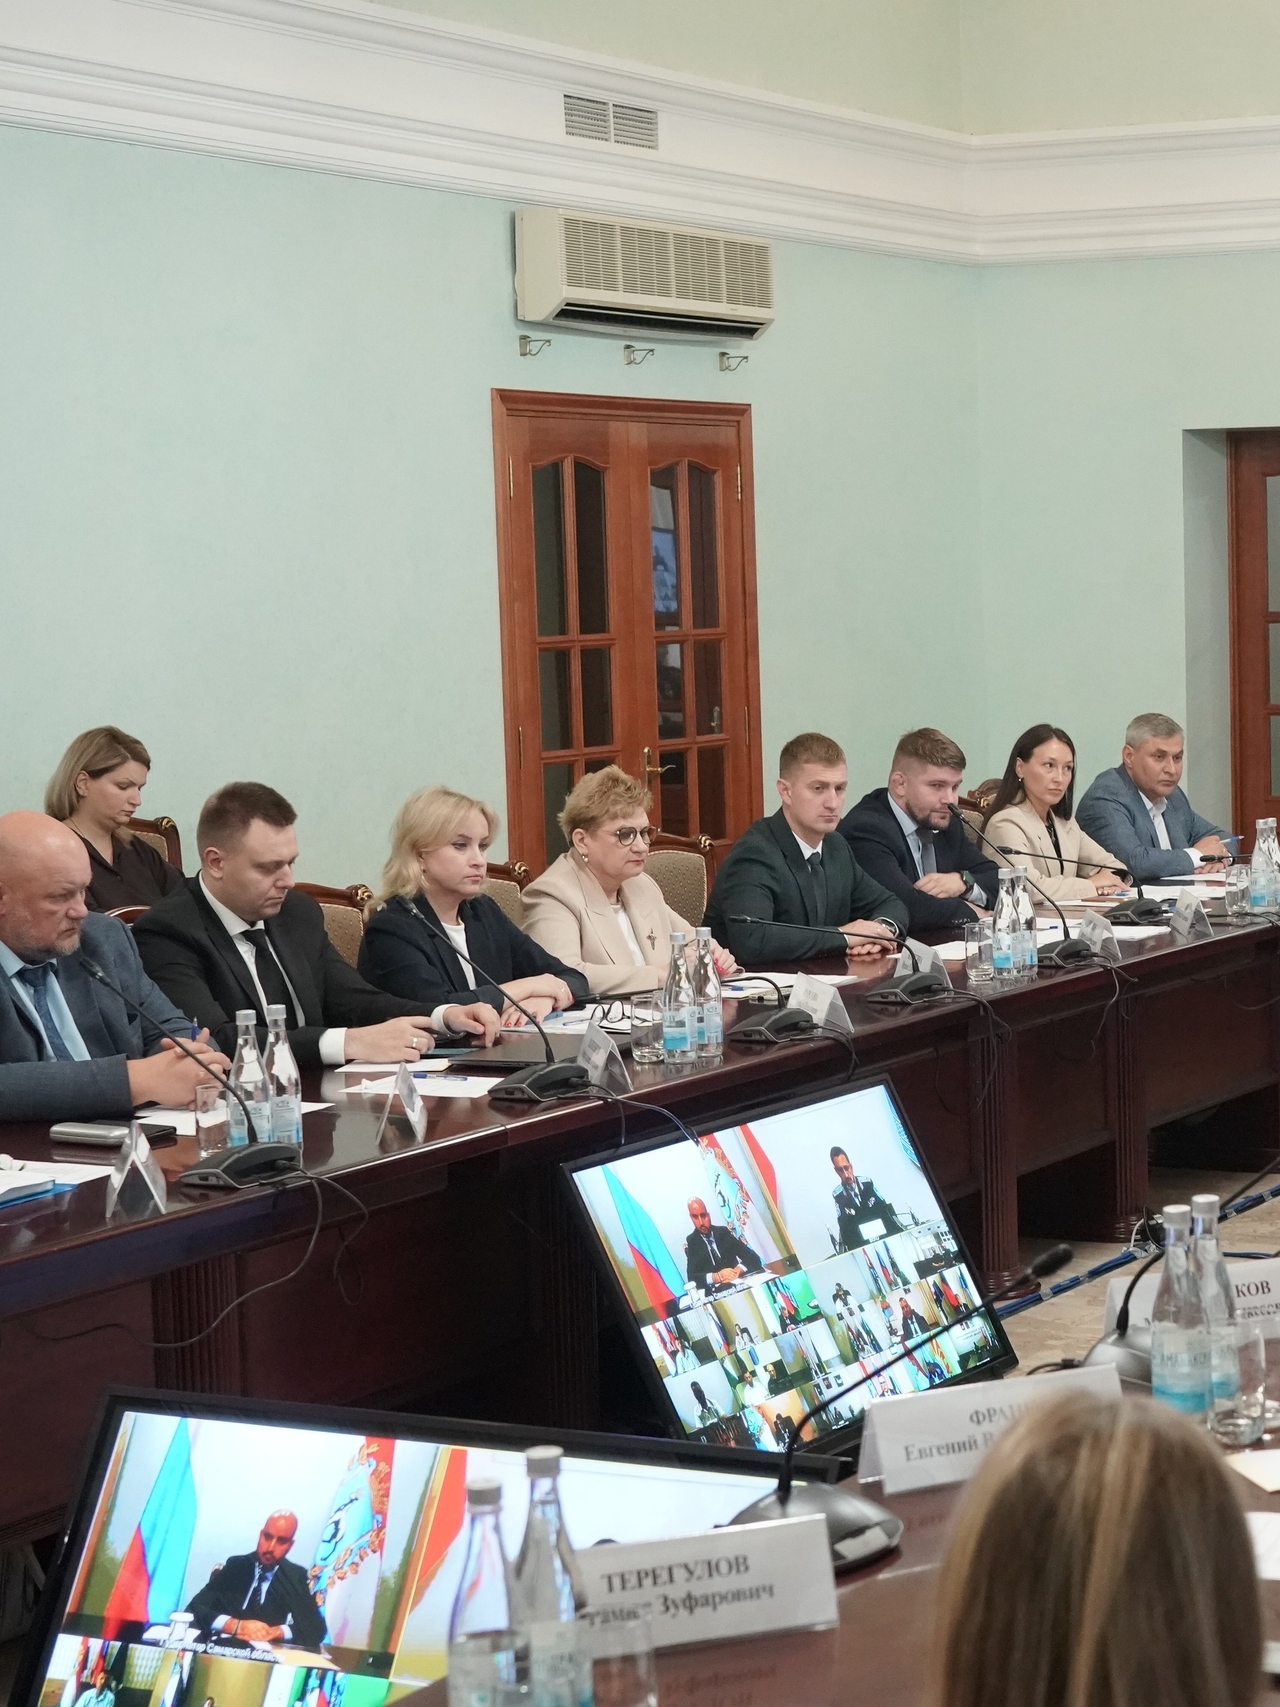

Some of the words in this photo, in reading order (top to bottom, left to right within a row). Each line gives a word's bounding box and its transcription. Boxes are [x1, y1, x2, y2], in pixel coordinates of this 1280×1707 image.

[1235, 1280, 1272, 1298] КОВ
[904, 1436, 979, 1462] Евгений
[601, 1553, 750, 1594] ТЕРЕГУЛОВ
[657, 1583, 775, 1619] Зуфарович
